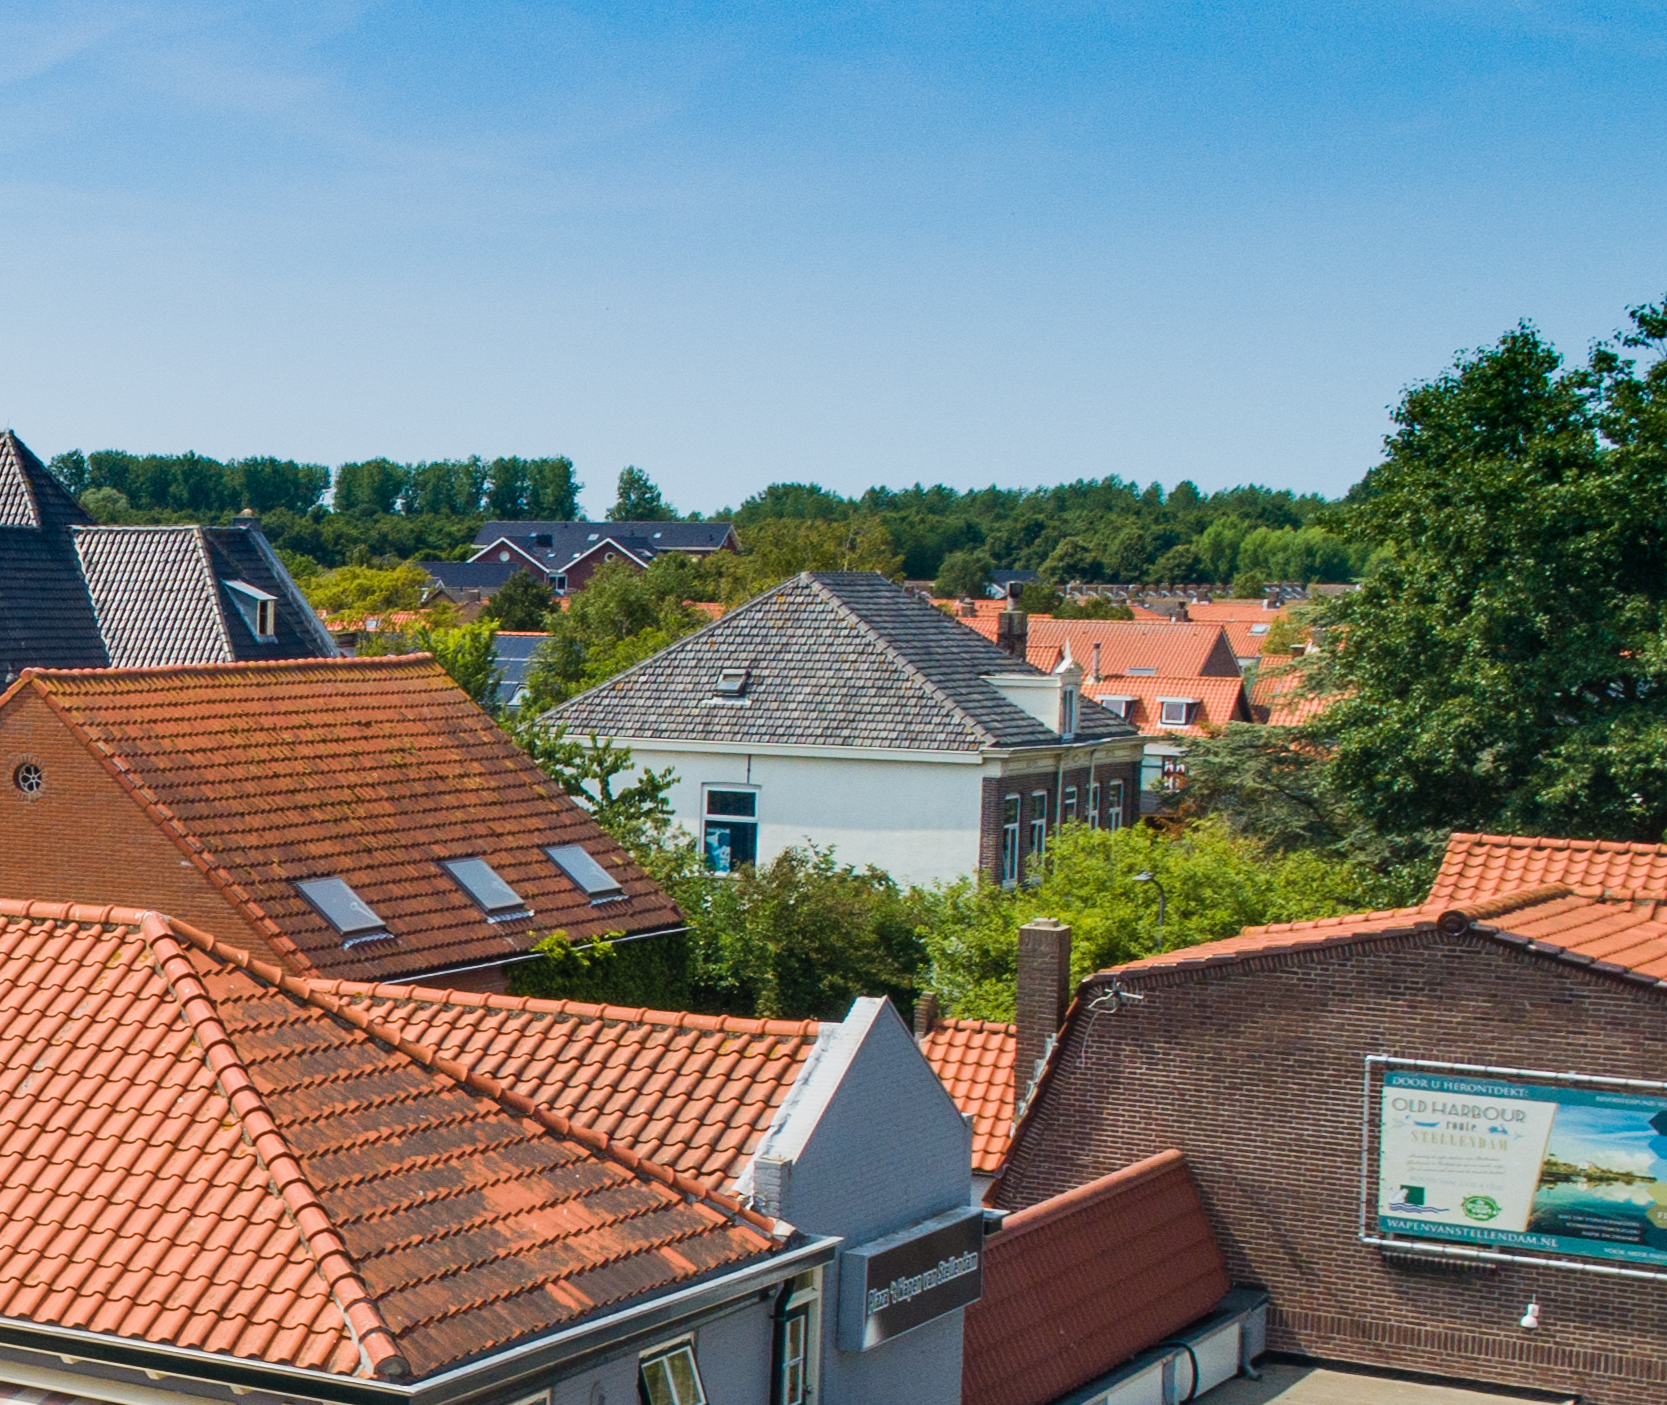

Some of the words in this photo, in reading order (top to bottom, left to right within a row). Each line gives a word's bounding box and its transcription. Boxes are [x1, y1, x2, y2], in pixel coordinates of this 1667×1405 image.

[1392, 1076, 1428, 1088] DOOR
[1431, 1080, 1440, 1088] U
[1443, 1082, 1529, 1098] HERONTDEKT:
[1391, 1097, 1427, 1113] OLD
[1431, 1100, 1526, 1124] HARBOUR
[1445, 1120, 1478, 1132] route
[1410, 1129, 1509, 1151] STELLENDAM
[1386, 1218, 1559, 1248] WAPENVANSTELLENDAM.NL
[937, 1251, 978, 1285] Stellendam
